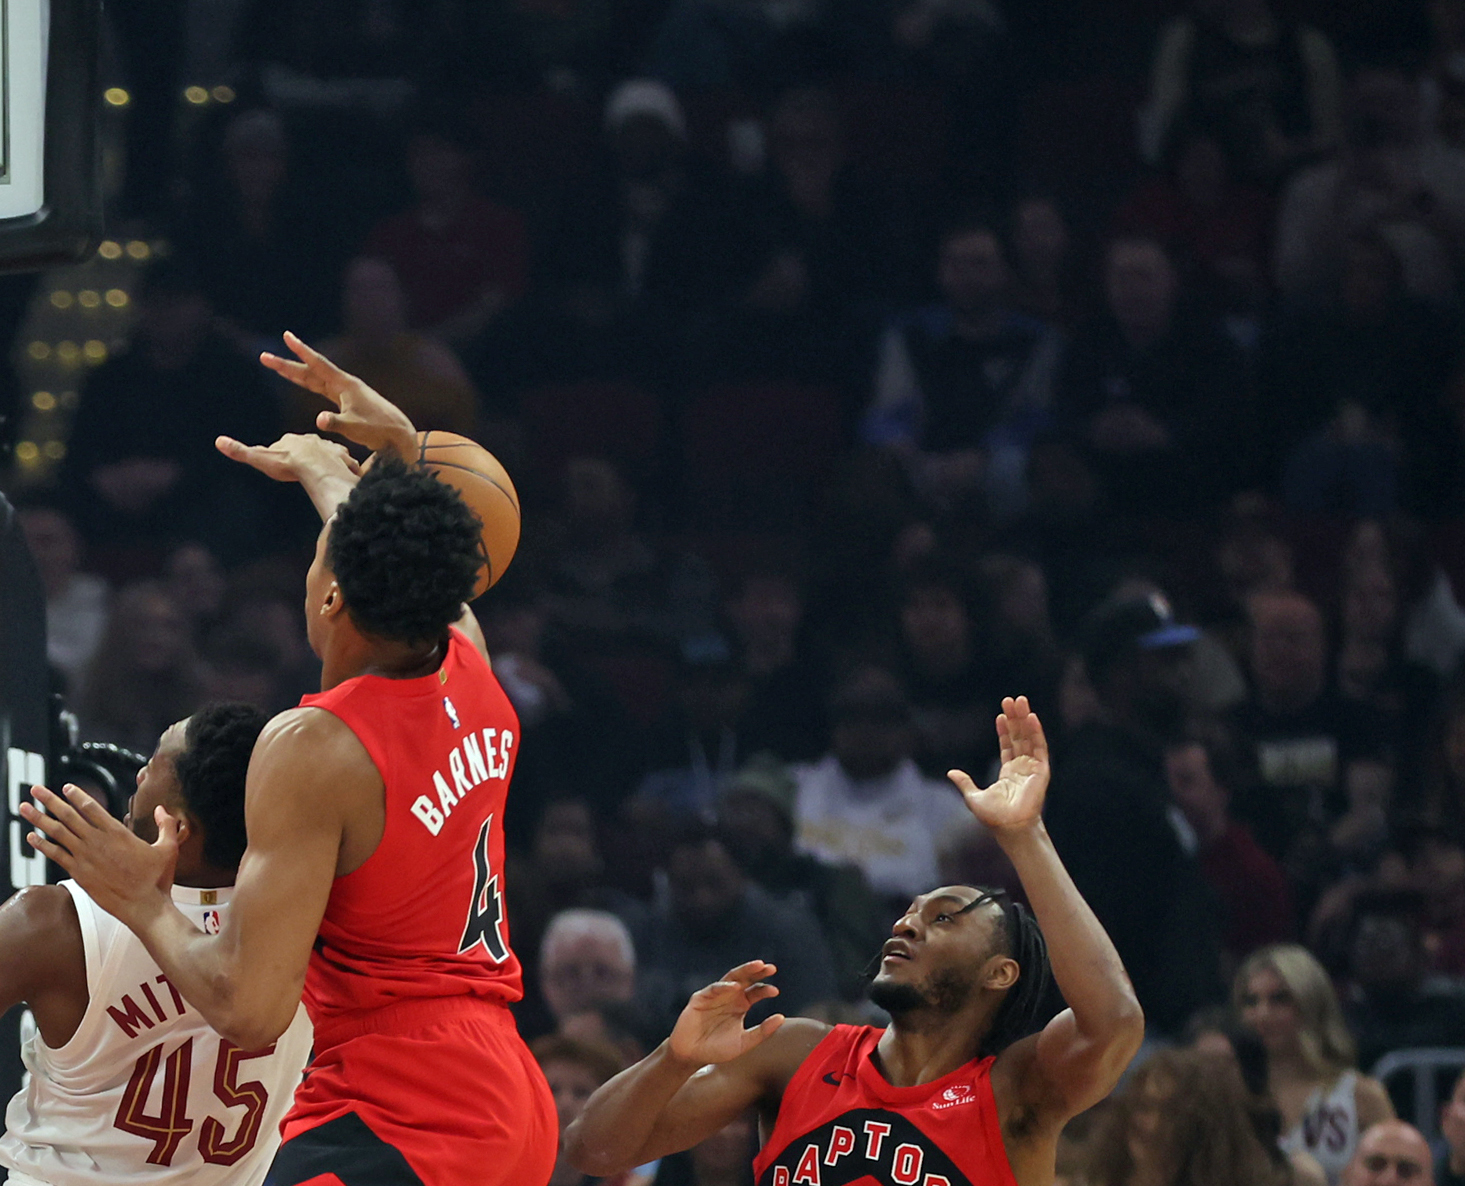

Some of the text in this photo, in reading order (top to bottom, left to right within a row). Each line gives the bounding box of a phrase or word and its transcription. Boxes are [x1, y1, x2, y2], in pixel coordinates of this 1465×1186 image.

[410, 727, 514, 837] BARNES
[456, 812, 510, 975] 4
[105, 973, 186, 1039] MIT
[113, 1035, 278, 1167] 45
